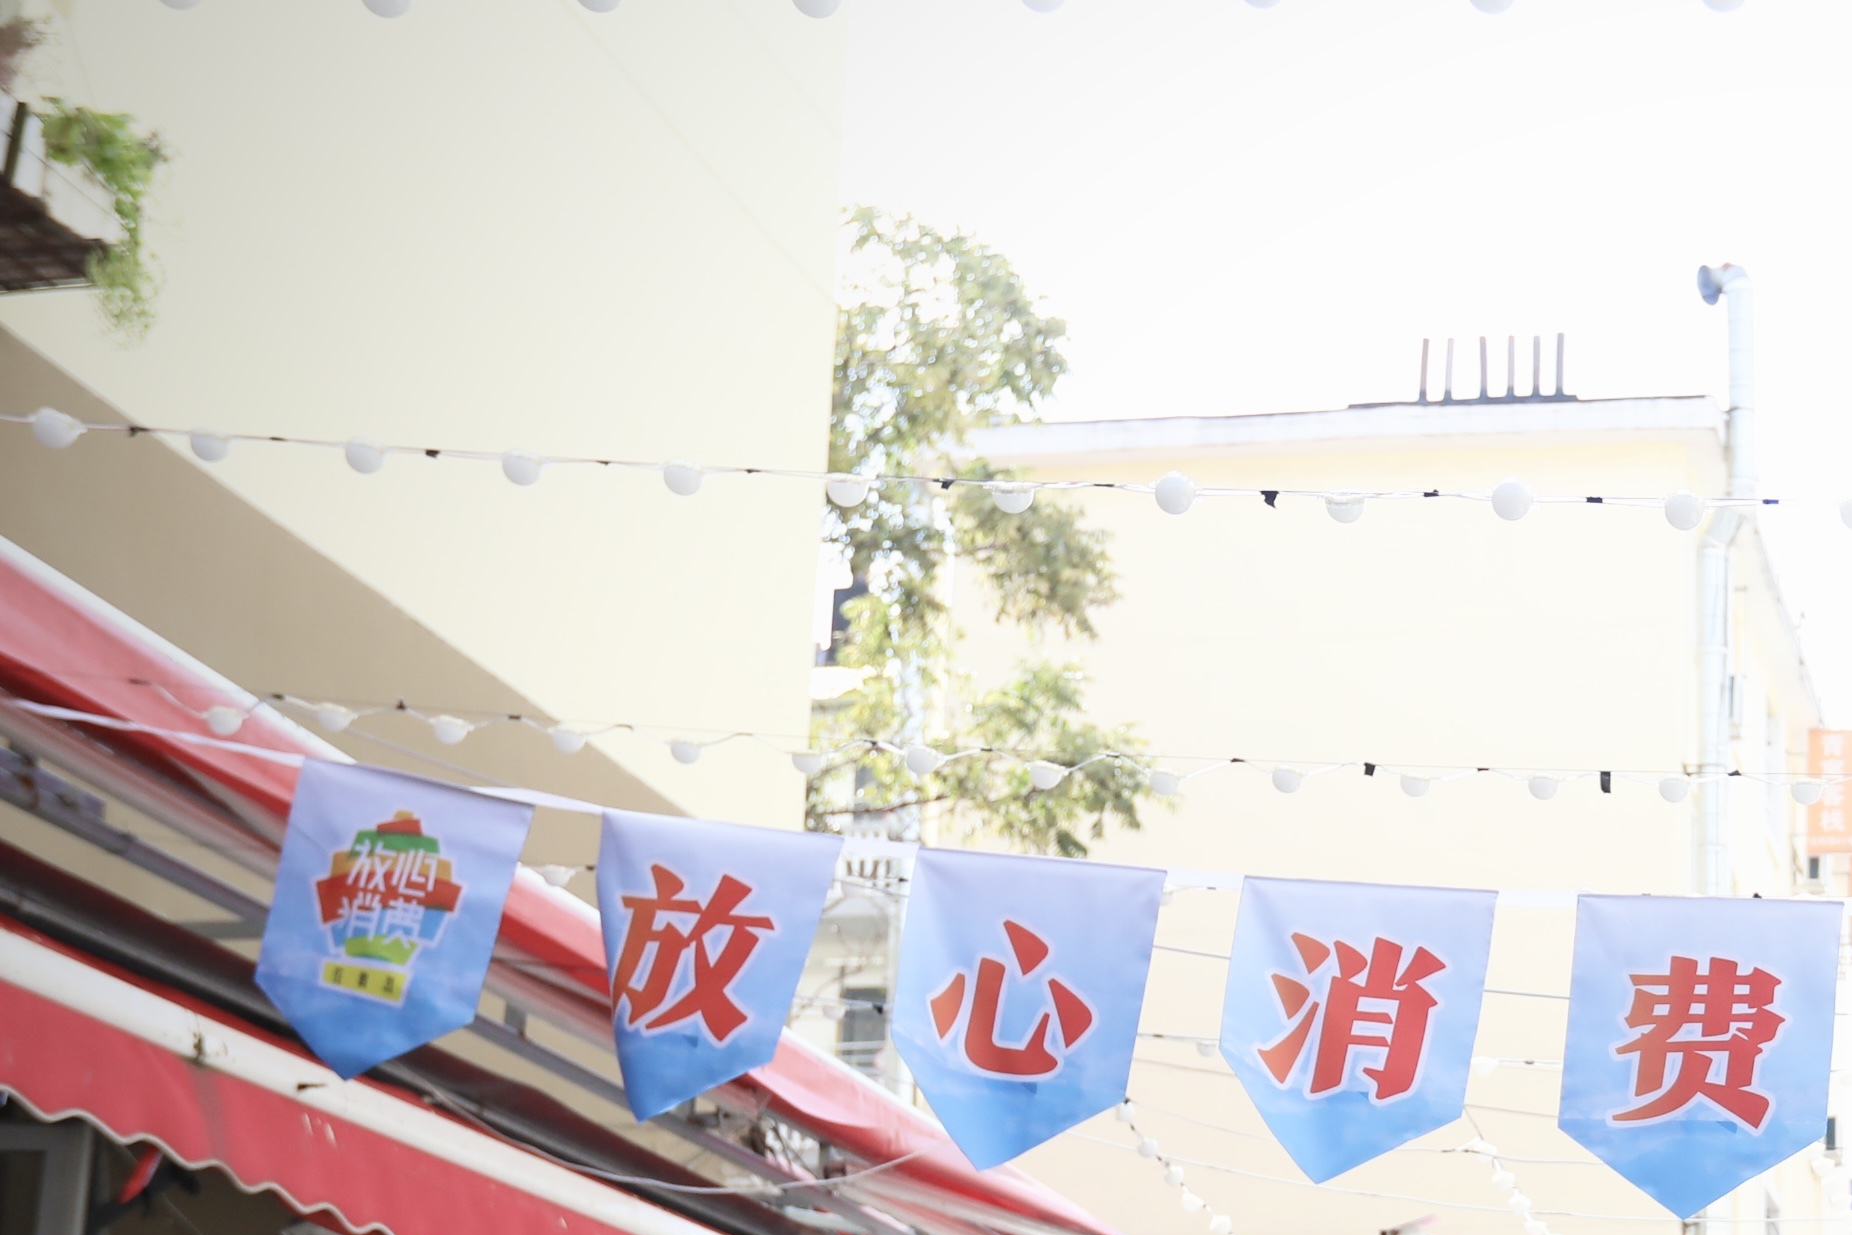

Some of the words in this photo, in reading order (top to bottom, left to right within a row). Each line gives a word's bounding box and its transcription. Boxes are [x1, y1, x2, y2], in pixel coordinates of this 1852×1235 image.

[347, 839, 437, 896] 放心
[614, 863, 776, 1044] 放
[928, 919, 1095, 1077] 心
[1258, 931, 1447, 1102] 消
[1611, 955, 1787, 1129] 费
